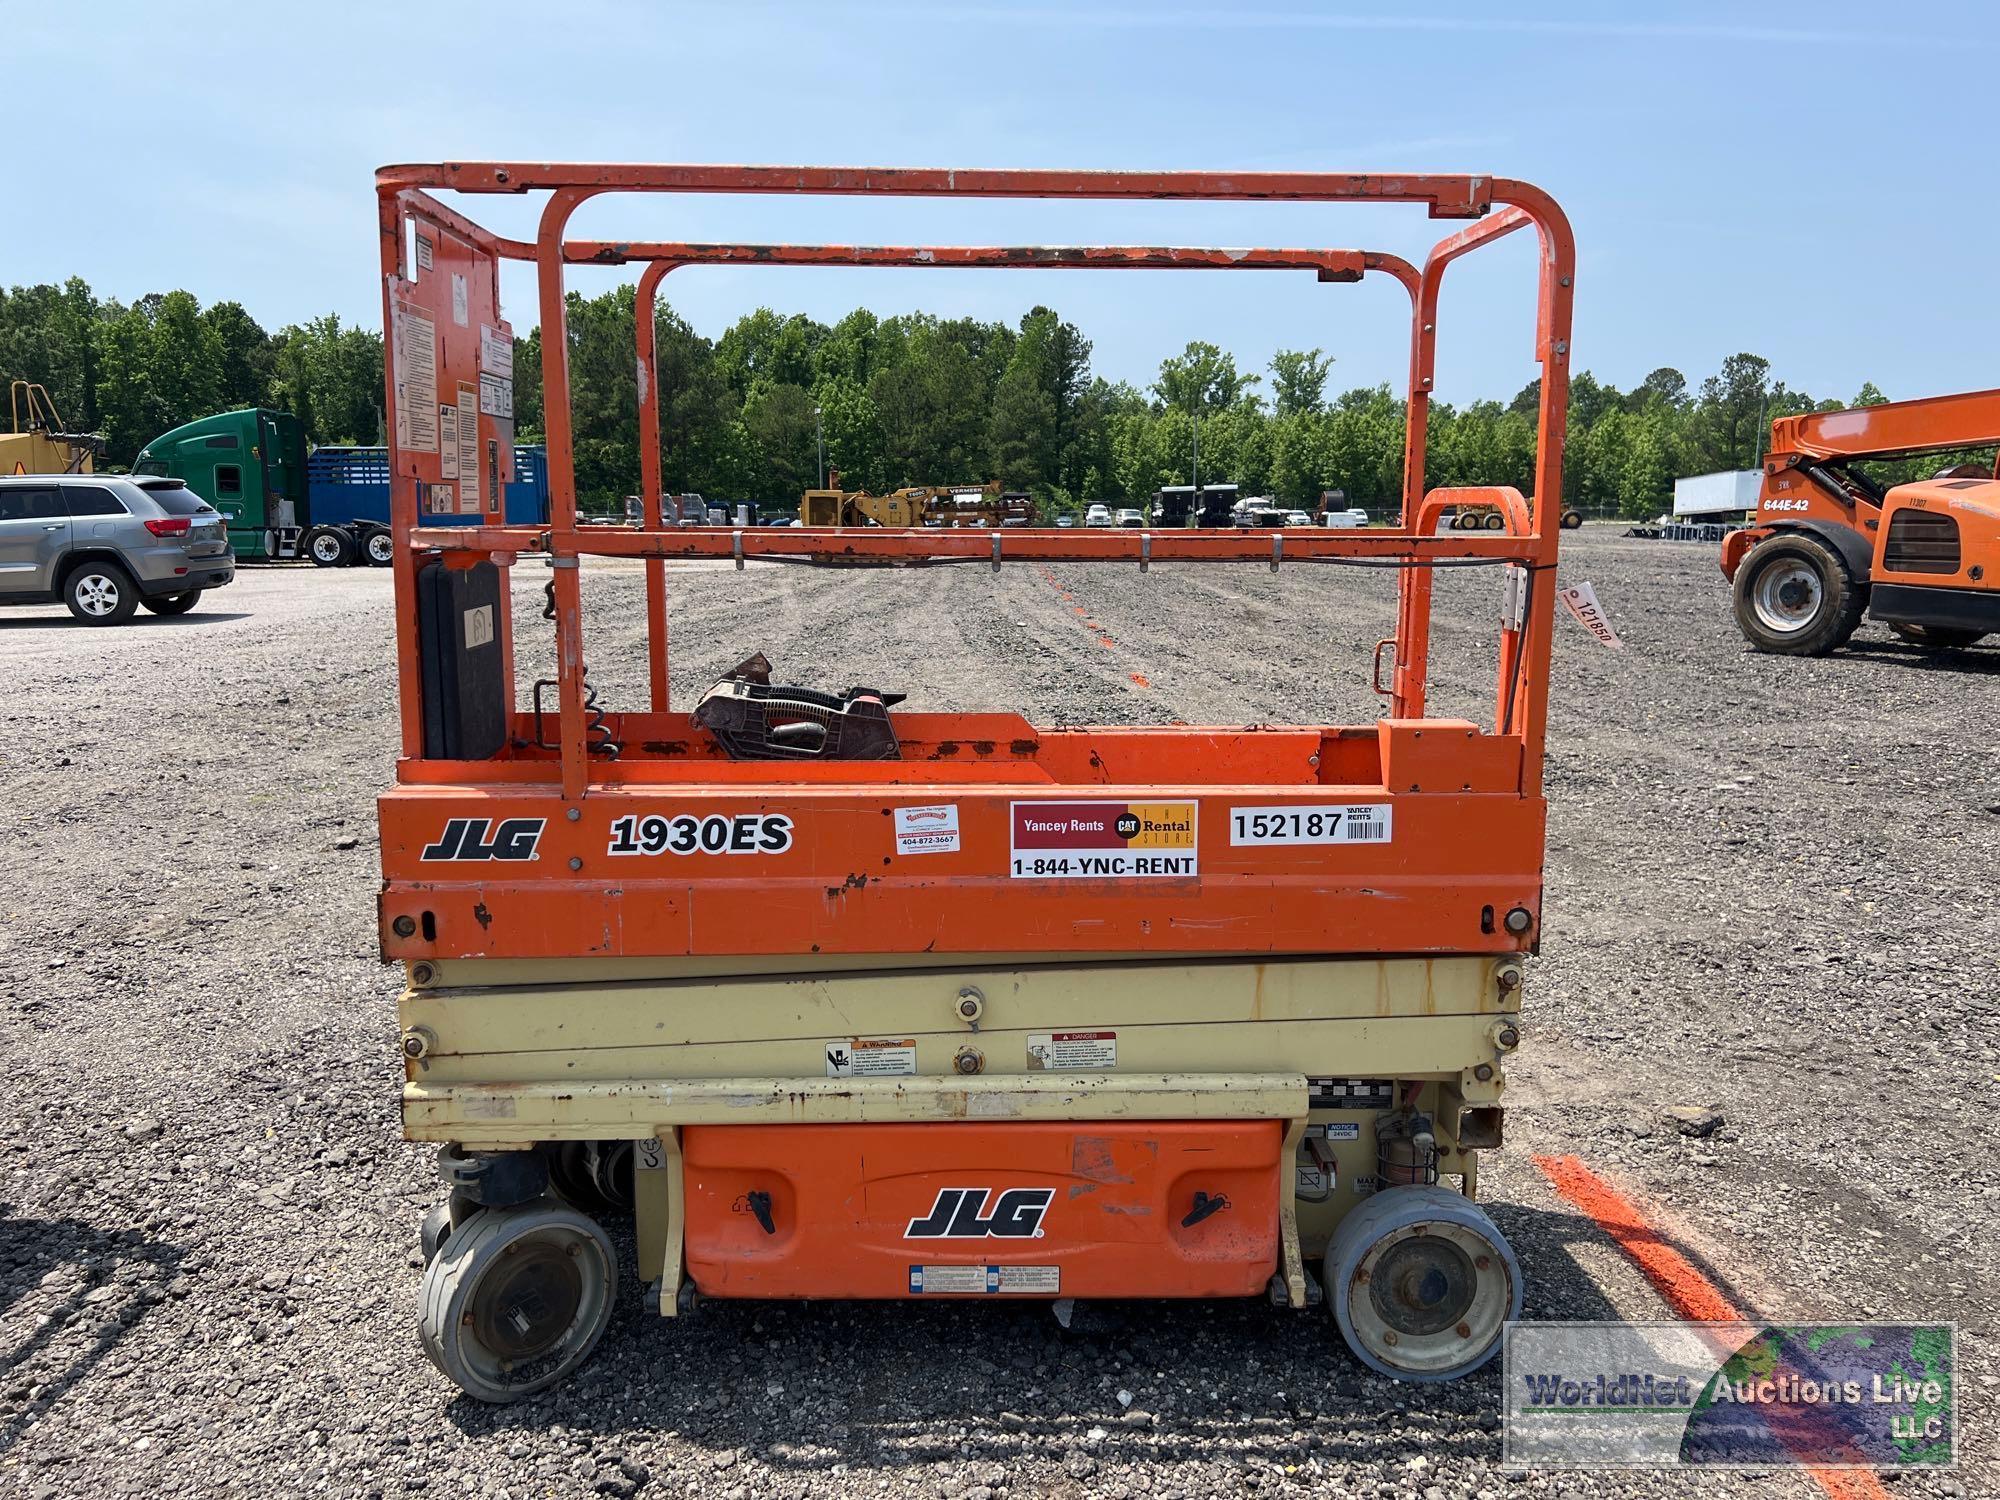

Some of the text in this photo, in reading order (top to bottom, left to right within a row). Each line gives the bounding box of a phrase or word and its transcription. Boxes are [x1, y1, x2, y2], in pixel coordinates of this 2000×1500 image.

[1763, 499, 1809, 511] 644E-42
[1578, 601, 1612, 641] 121850
[1143, 808, 1190, 819] THE
[1024, 819, 1104, 834] Yancey Rents
[1118, 820, 1137, 832] CAT
[1143, 820, 1191, 832] Rental
[1235, 813, 1342, 839] 152187
[421, 818, 547, 861] JLG
[609, 815, 791, 854] 1930ES
[902, 836, 954, 845] 404-872-3667
[1013, 857, 1195, 875] 1-844-YNC-RENT
[903, 1188, 1056, 1239] JLG
